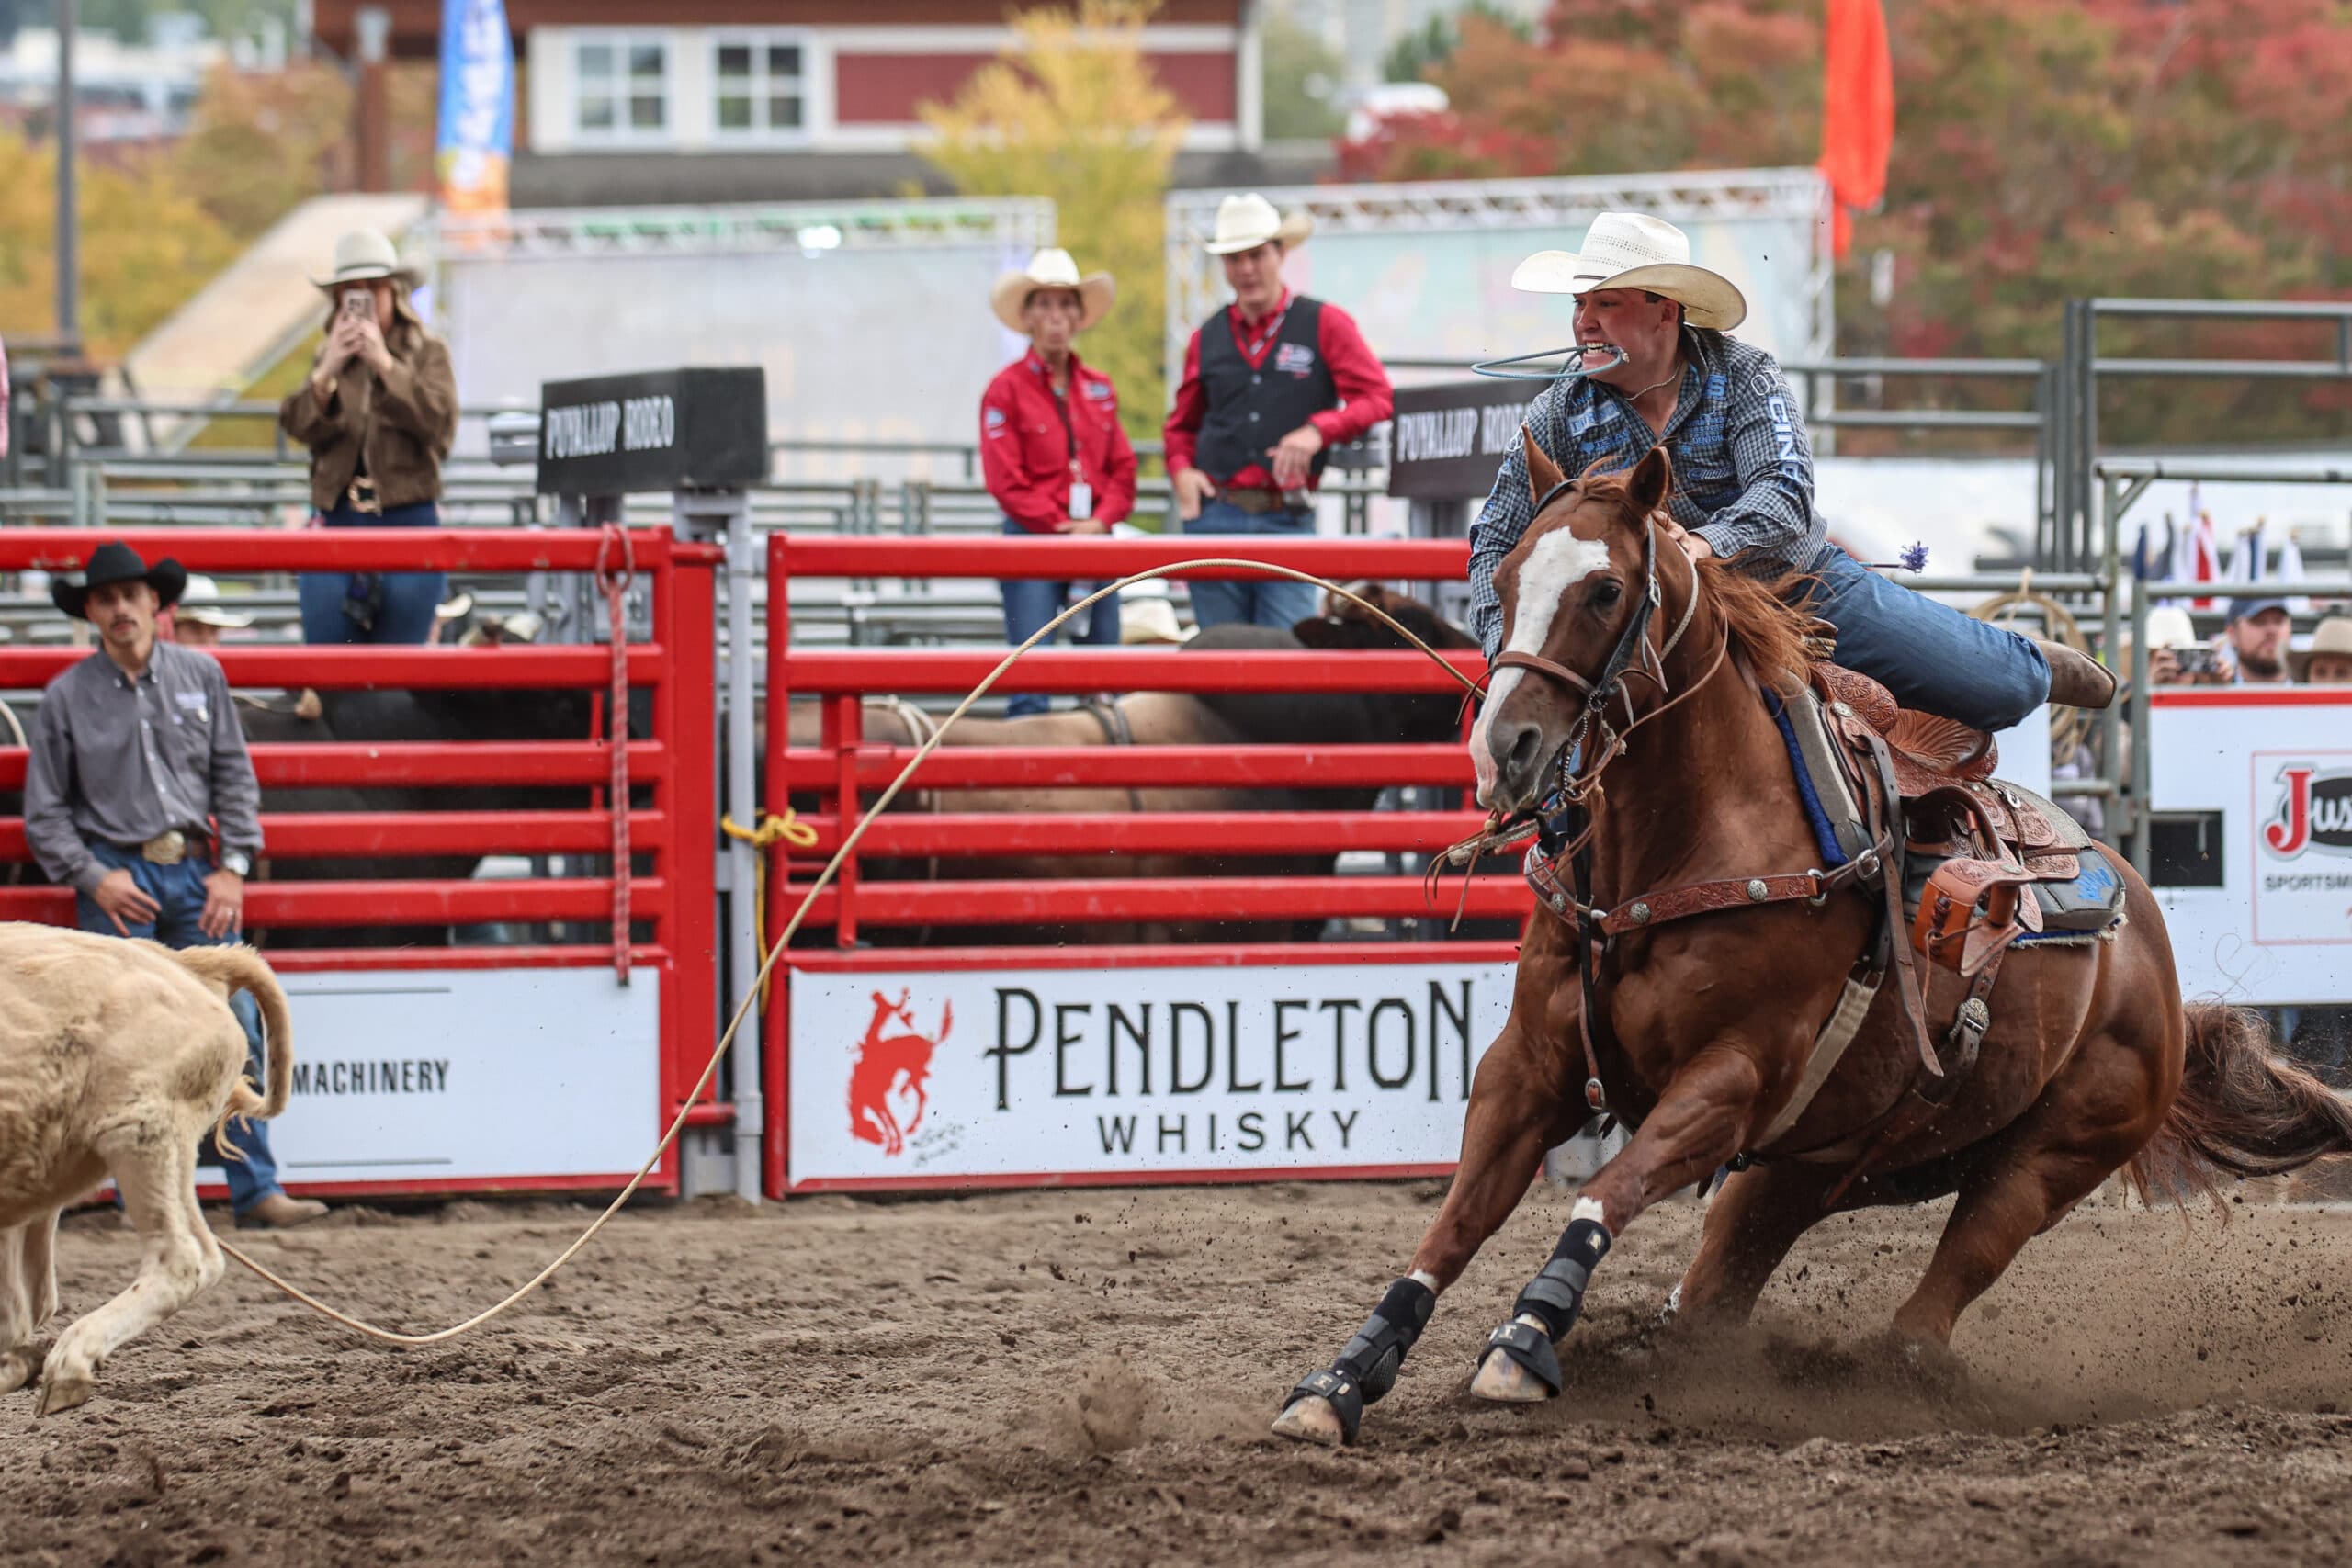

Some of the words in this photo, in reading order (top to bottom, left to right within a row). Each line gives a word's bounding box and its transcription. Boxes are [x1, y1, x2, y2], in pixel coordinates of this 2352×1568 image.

[546, 400, 621, 459] PUYALLUP
[623, 394, 675, 451] RODEO
[1396, 407, 1479, 463] PUYALLUP
[982, 979, 1474, 1112] PENDLETON
[283, 1060, 450, 1095] MACHINERY
[1097, 1110, 1360, 1155] WHISKY
